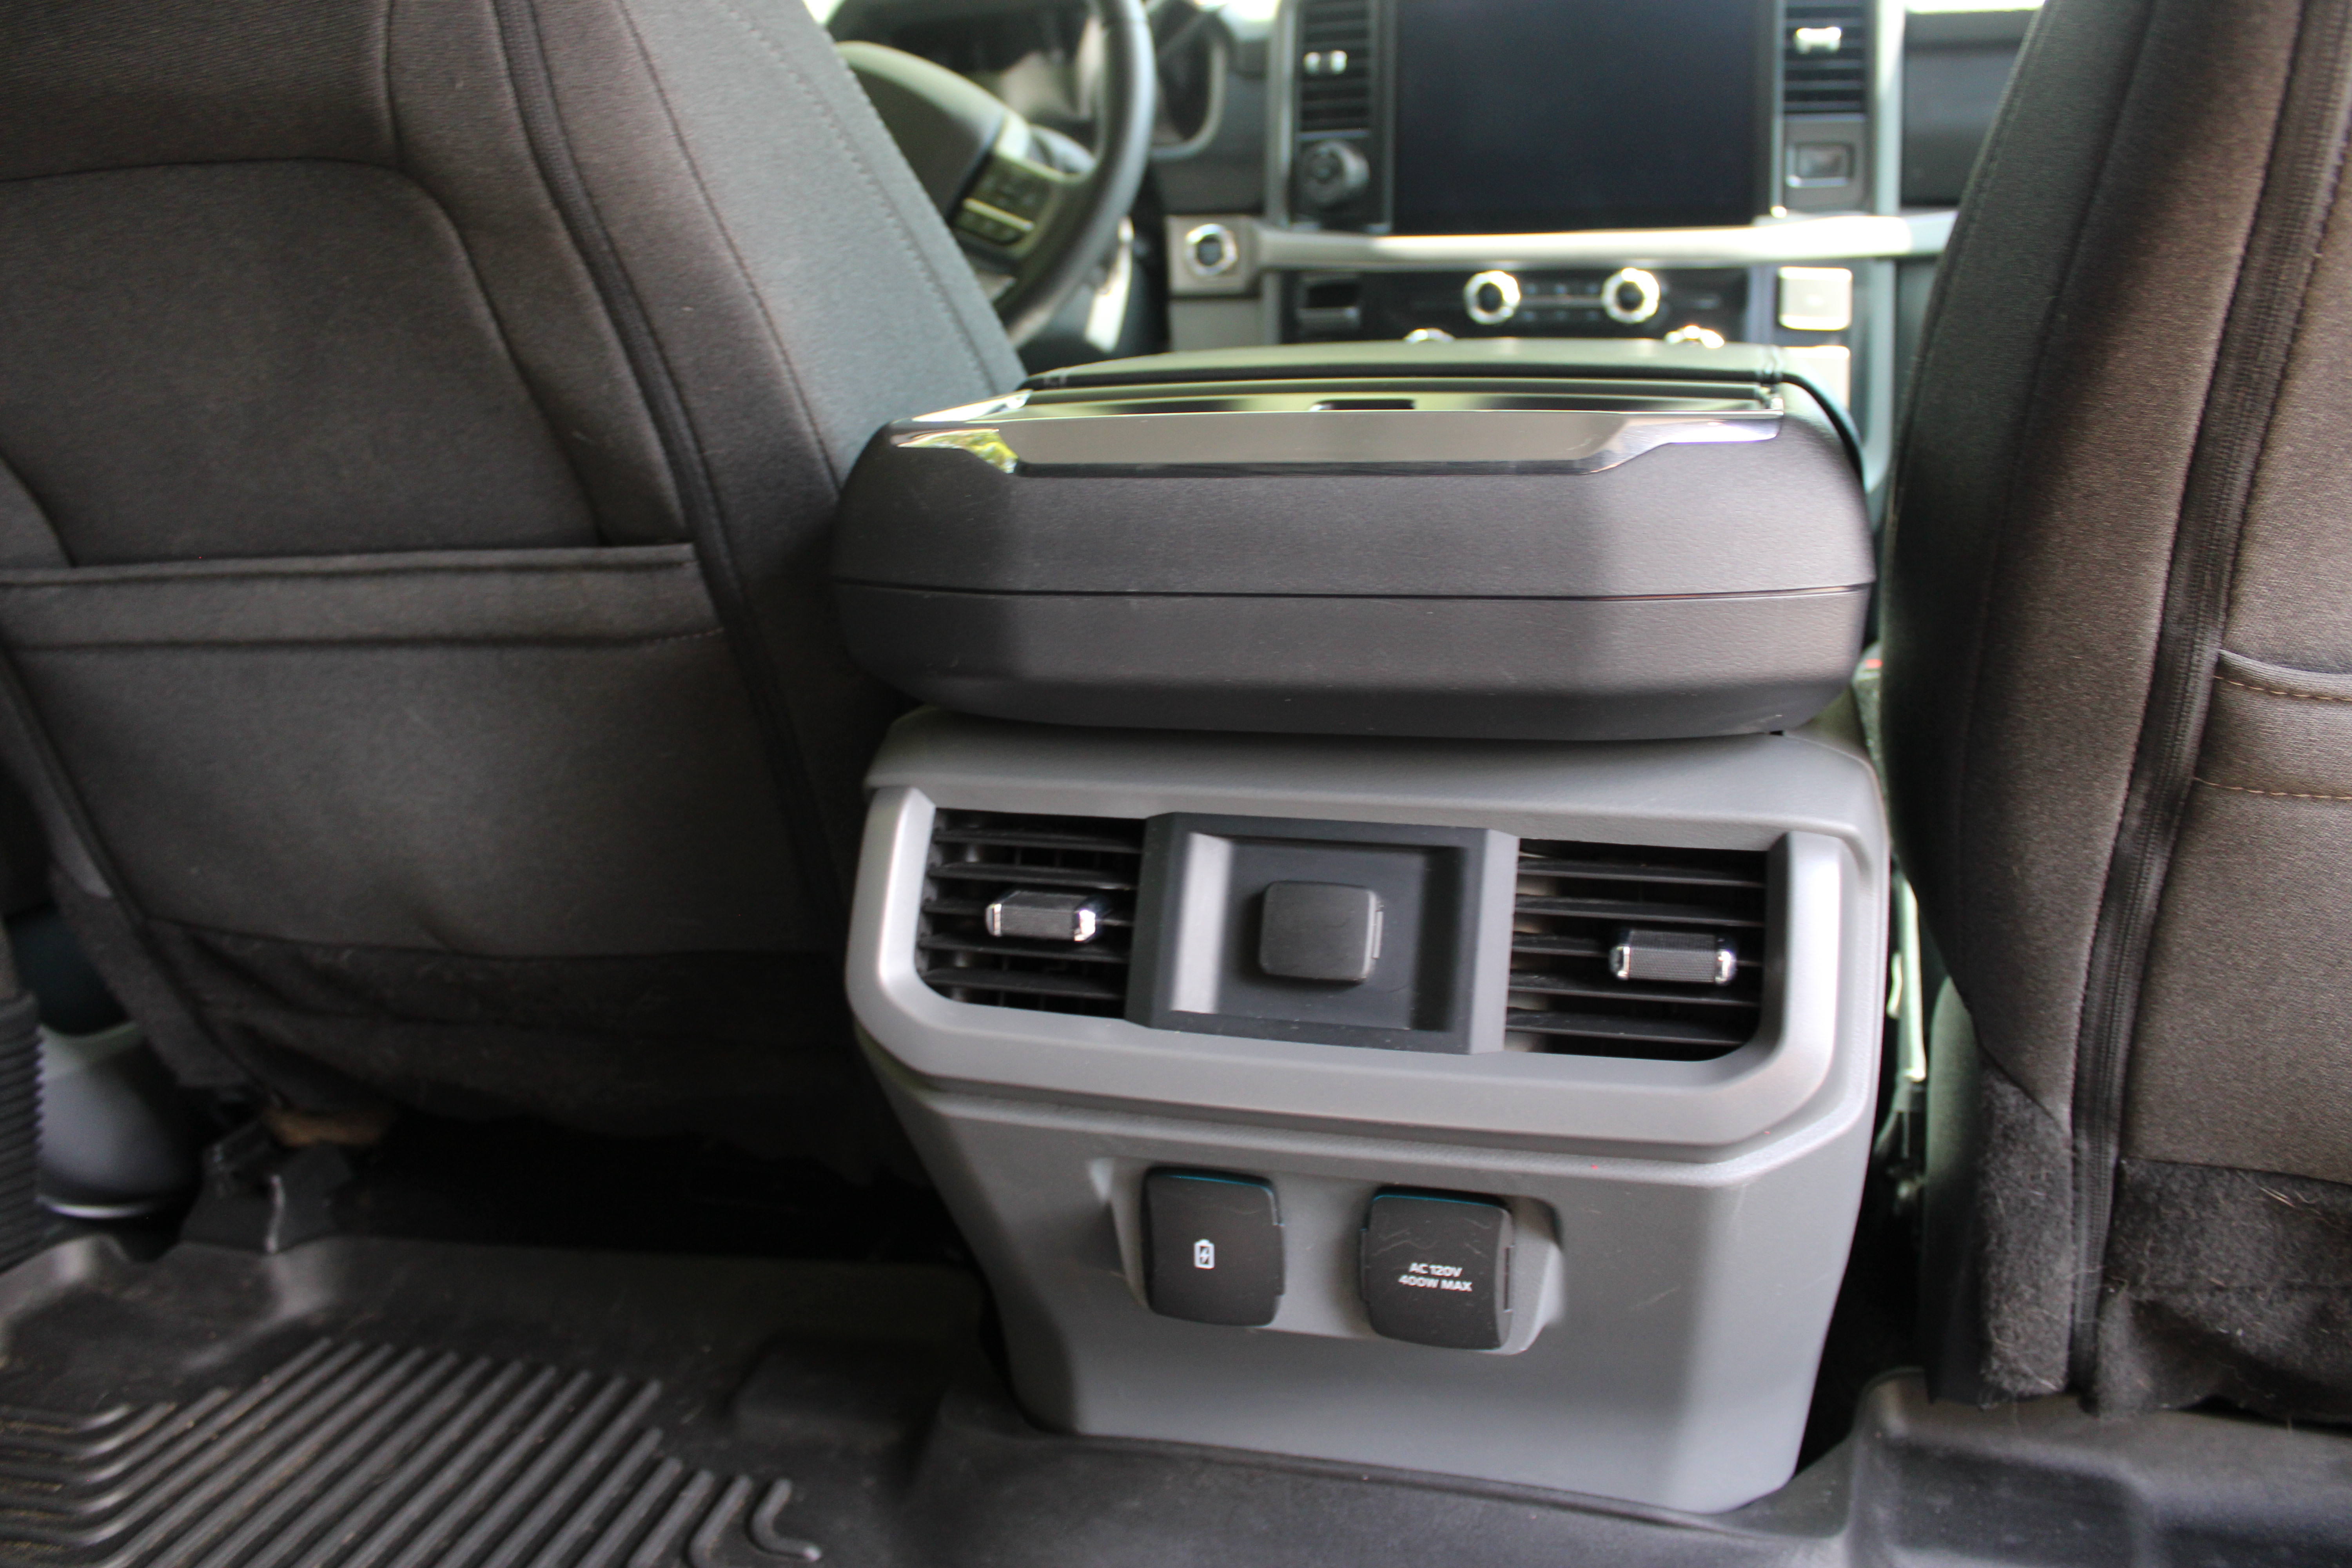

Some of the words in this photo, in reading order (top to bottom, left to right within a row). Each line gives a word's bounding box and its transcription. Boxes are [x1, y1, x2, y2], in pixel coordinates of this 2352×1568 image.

[1409, 1263, 1428, 1274] AC
[1429, 1265, 1462, 1277] 120V
[1399, 1275, 1439, 1289] 400W
[1441, 1279, 1472, 1292] MAX
